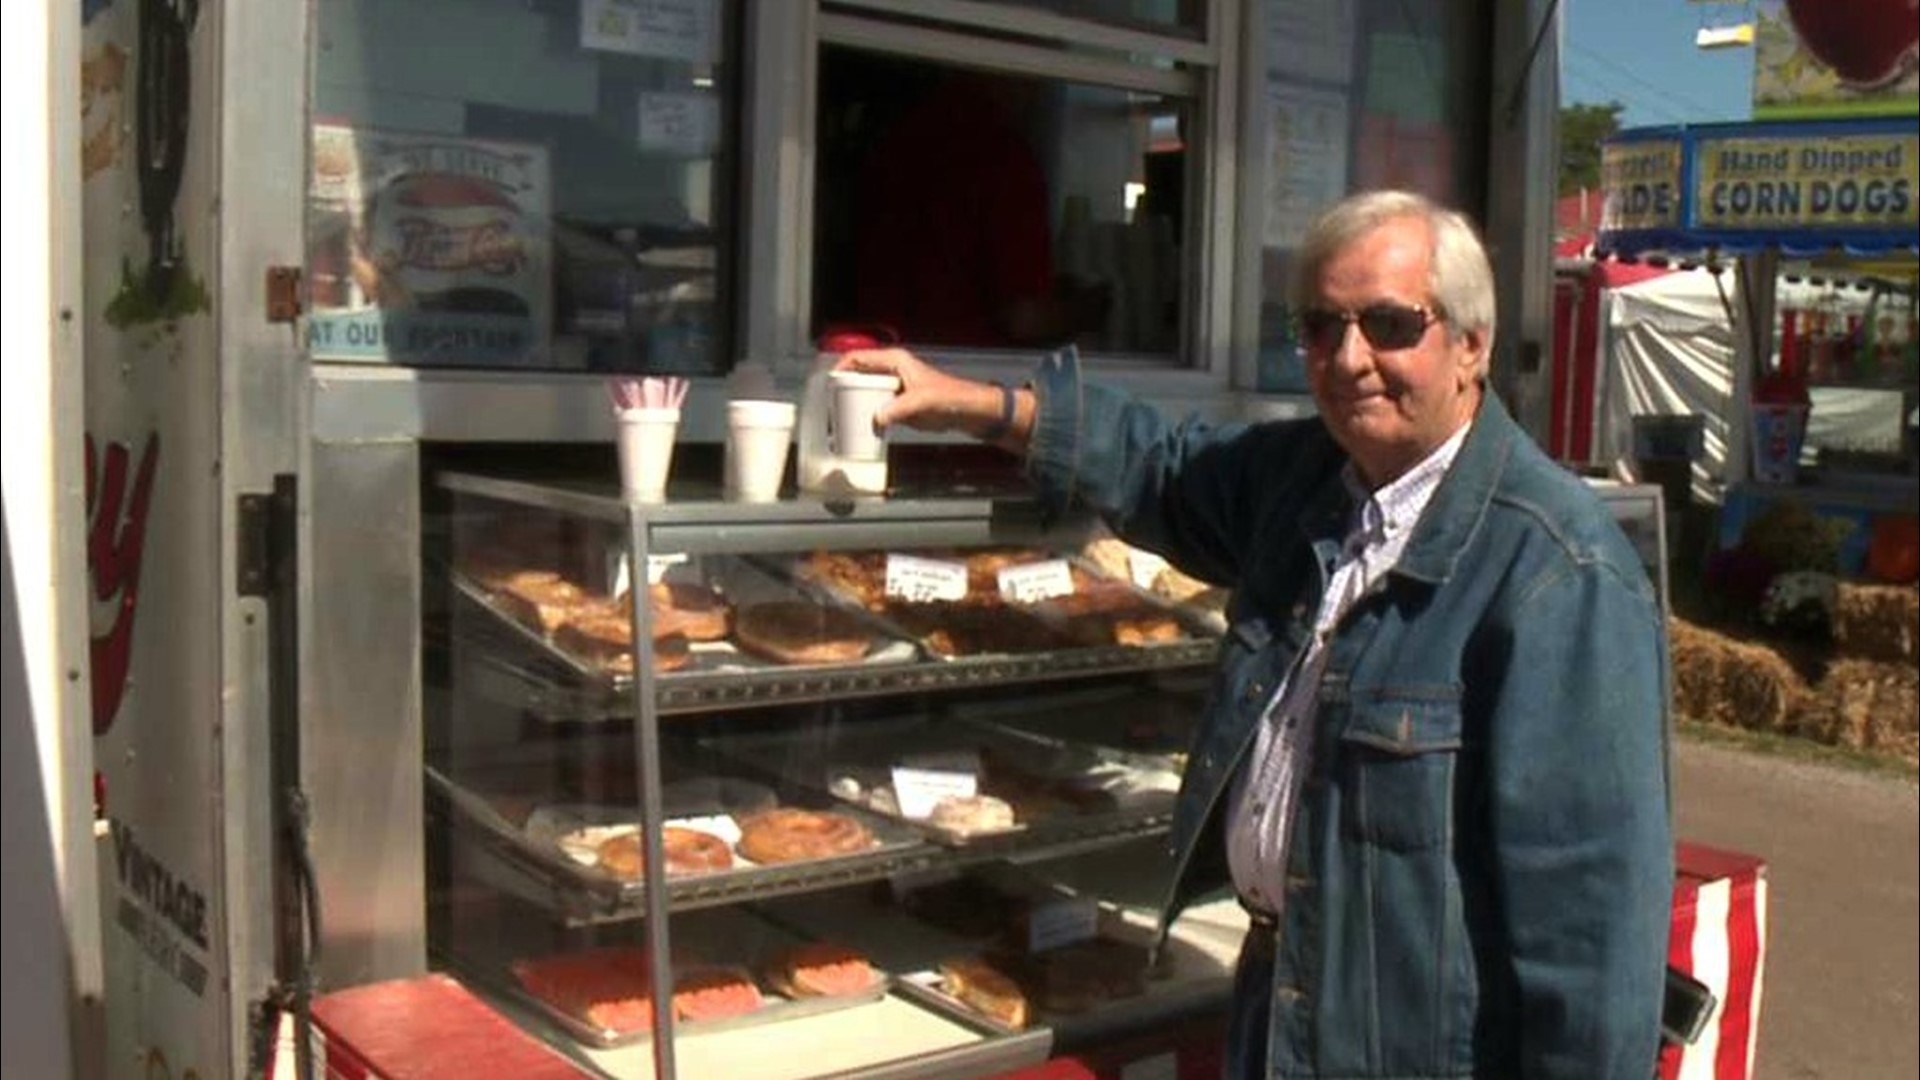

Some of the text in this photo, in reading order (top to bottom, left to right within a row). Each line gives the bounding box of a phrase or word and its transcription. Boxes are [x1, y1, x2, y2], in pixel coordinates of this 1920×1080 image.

[1720, 143, 1904, 174] Hand Dipped
[1711, 178, 1911, 215] CORN DOGS
[309, 322, 336, 345] AT
